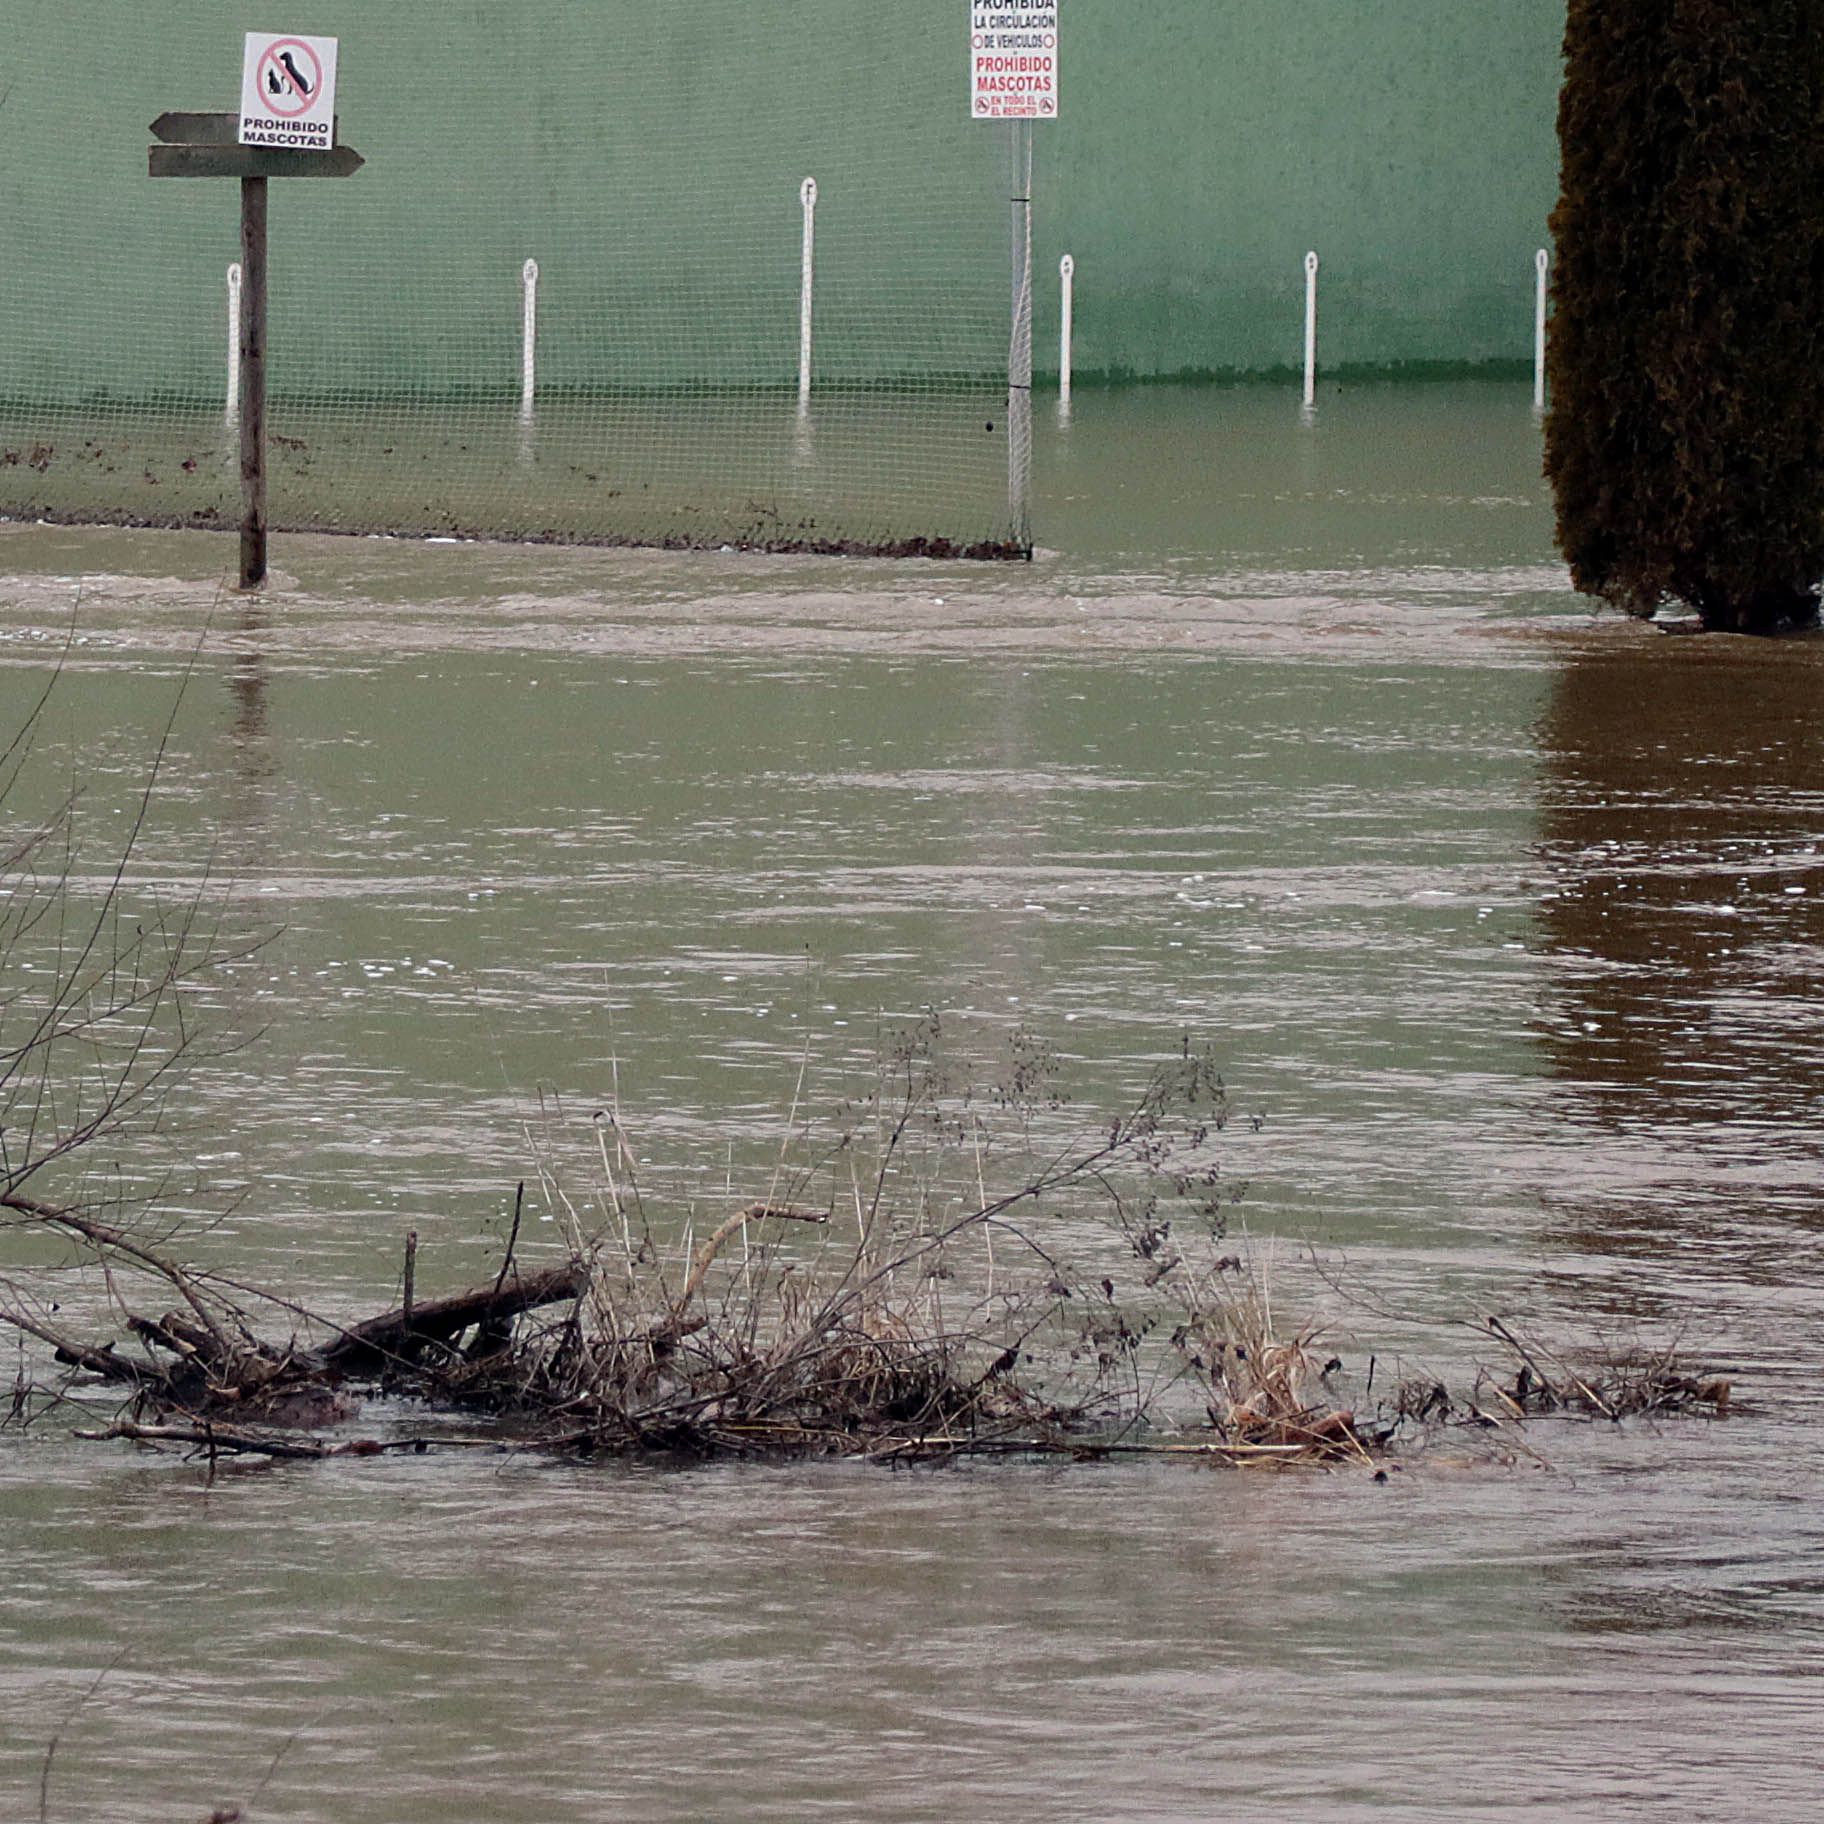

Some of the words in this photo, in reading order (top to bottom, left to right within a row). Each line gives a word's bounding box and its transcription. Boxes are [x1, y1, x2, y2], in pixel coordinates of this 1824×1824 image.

[974, 15, 986, 29] LA
[984, 34, 994, 48] DE
[976, 57, 1052, 72] PROHIBIDO
[977, 76, 1051, 91] MASCOTAS
[244, 117, 328, 134] PROHIBIDO
[243, 131, 327, 147] MASCOTAS
